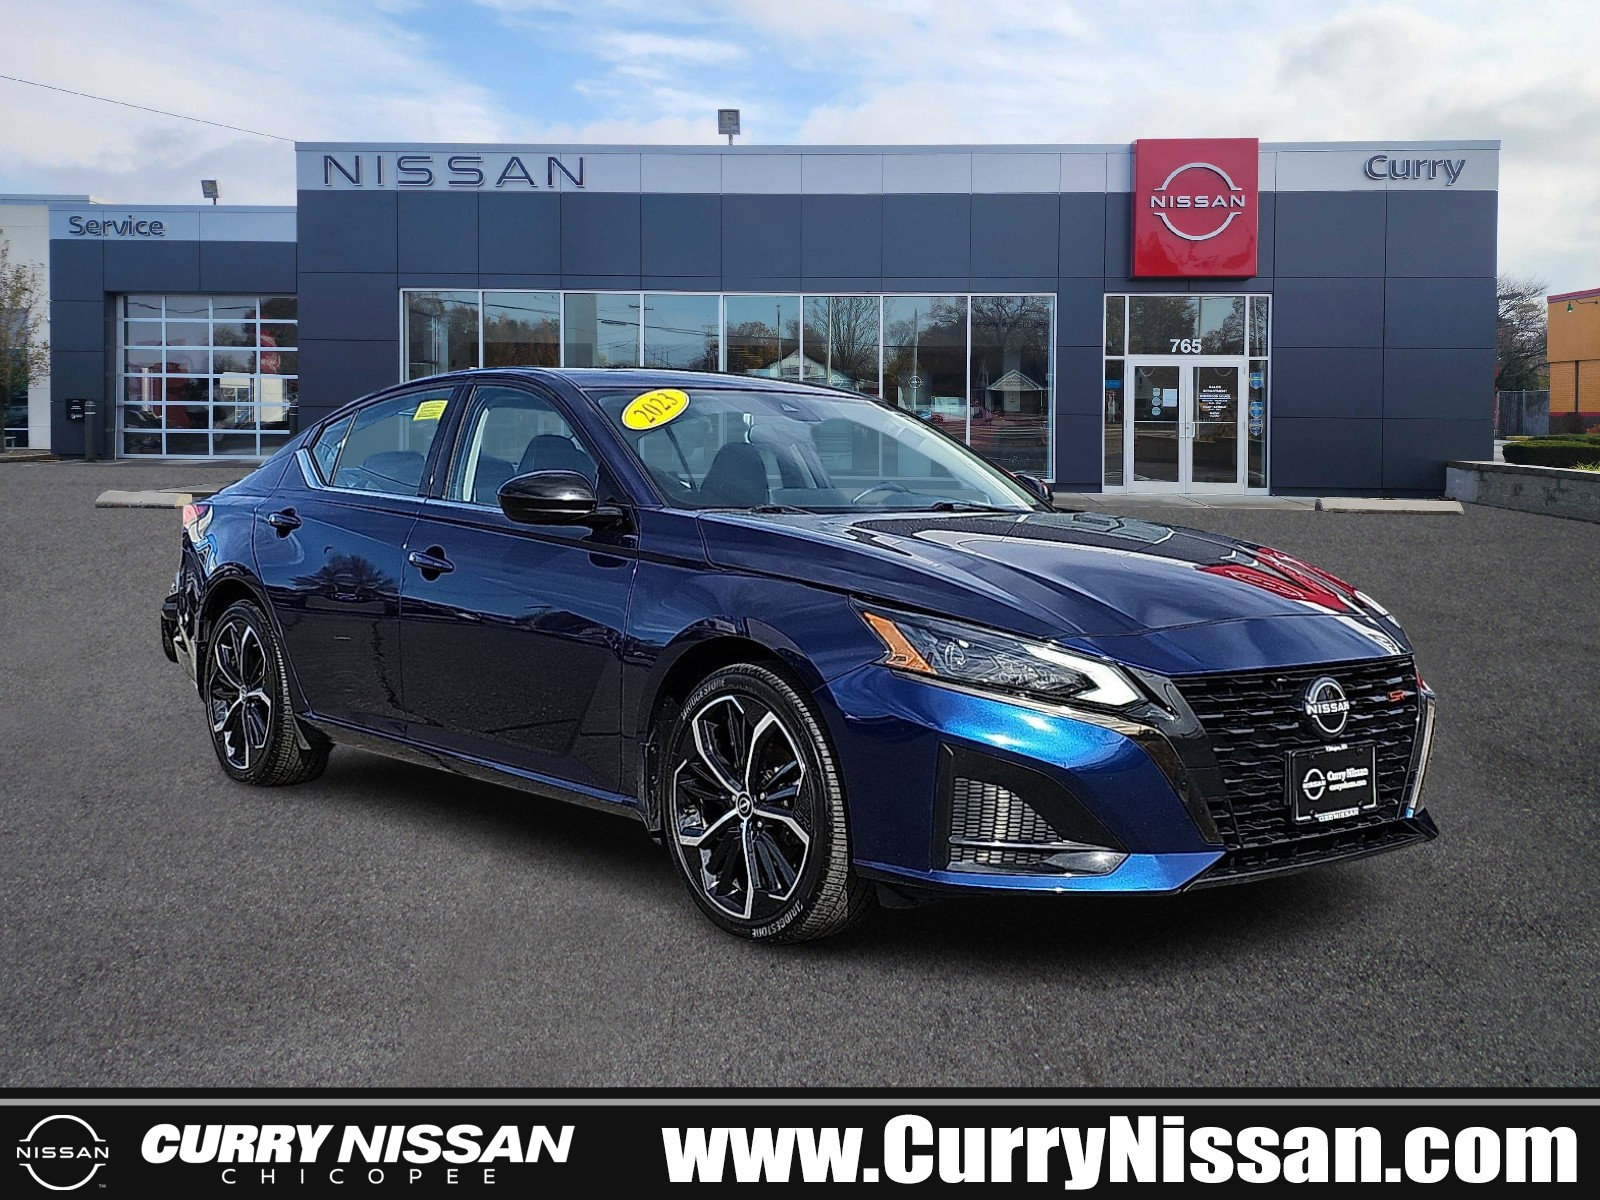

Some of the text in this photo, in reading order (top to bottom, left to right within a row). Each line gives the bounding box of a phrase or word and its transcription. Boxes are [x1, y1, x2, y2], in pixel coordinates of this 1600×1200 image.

[322, 152, 587, 189] NISSAN
[1364, 154, 1467, 186] Curry
[1150, 194, 1246, 208] NISSAN
[69, 214, 166, 237] Service
[1170, 338, 1202, 354] 765
[634, 392, 679, 424] 2023
[680, 678, 726, 721] BRIDGESTONE
[1387, 690, 1405, 703] SR
[1306, 701, 1350, 716] NISSAN
